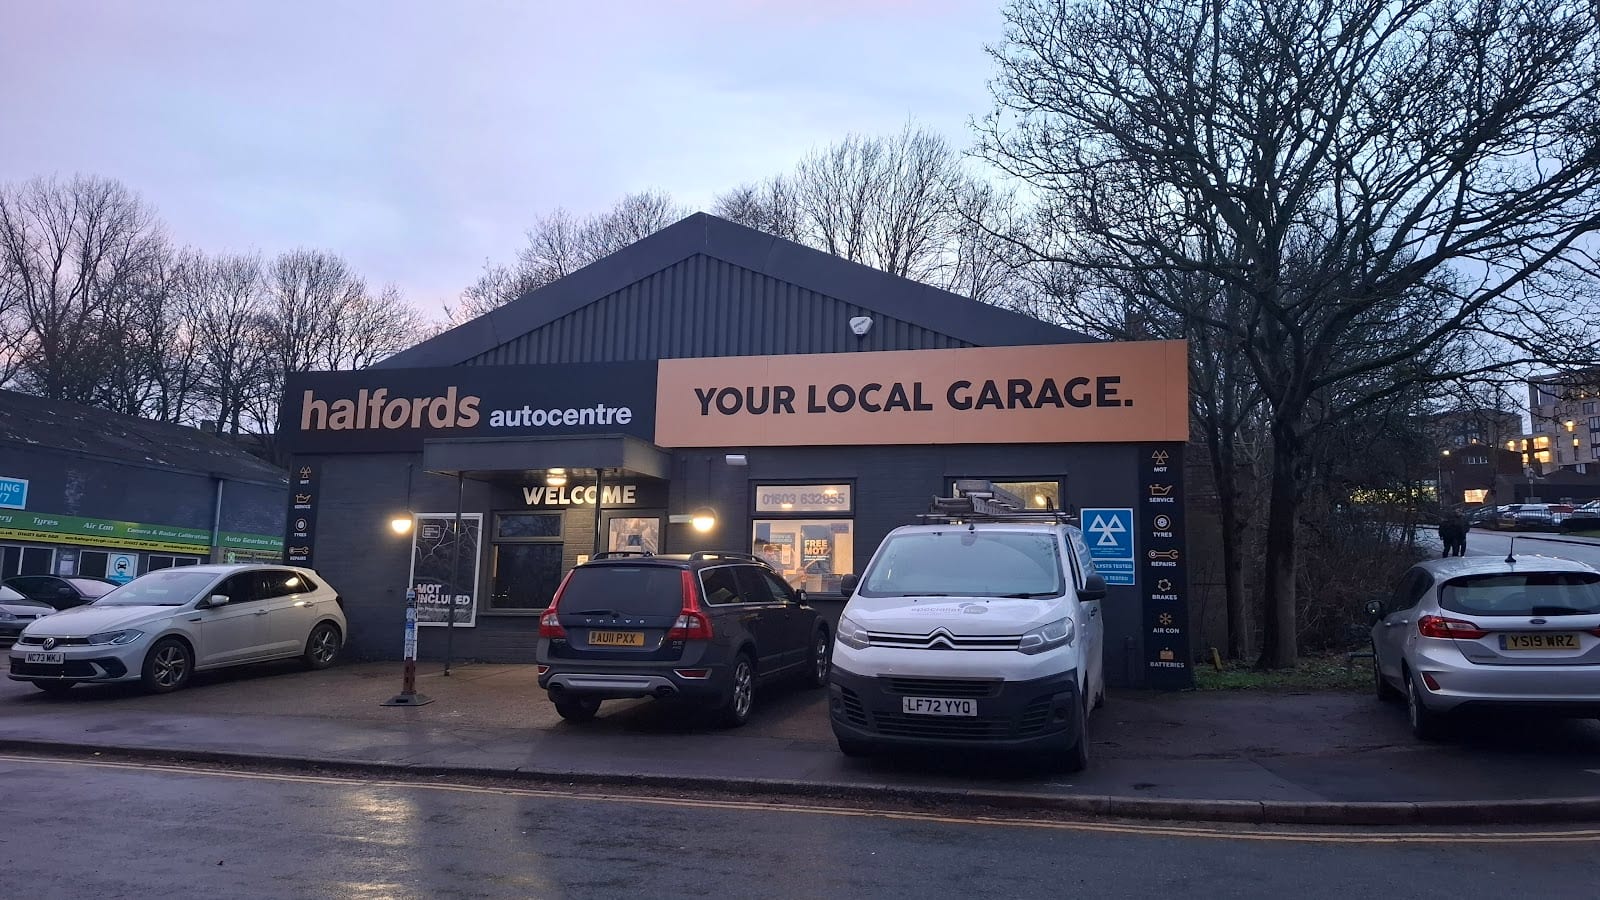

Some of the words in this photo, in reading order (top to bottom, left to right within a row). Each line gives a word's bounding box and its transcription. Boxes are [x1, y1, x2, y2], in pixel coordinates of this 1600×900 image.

[694, 385, 796, 415] YOUR
[807, 382, 933, 414] LOCAL
[946, 375, 1134, 411] GARAGE.
[300, 386, 481, 431] halfords
[489, 403, 632, 428] autocentre
[522, 485, 637, 505] WELCOME
[33, 517, 59, 526] Tyres
[98, 523, 114, 531] Con
[804, 539, 828, 548] FREE
[804, 547, 825, 555] MOT
[417, 583, 442, 594] MOT
[596, 631, 614, 644] AU11
[616, 632, 636, 645] PXX
[1510, 634, 1543, 647] YS19
[1546, 634, 1575, 647] WRZ
[908, 698, 941, 712] LF72
[945, 700, 970, 714] YYO
